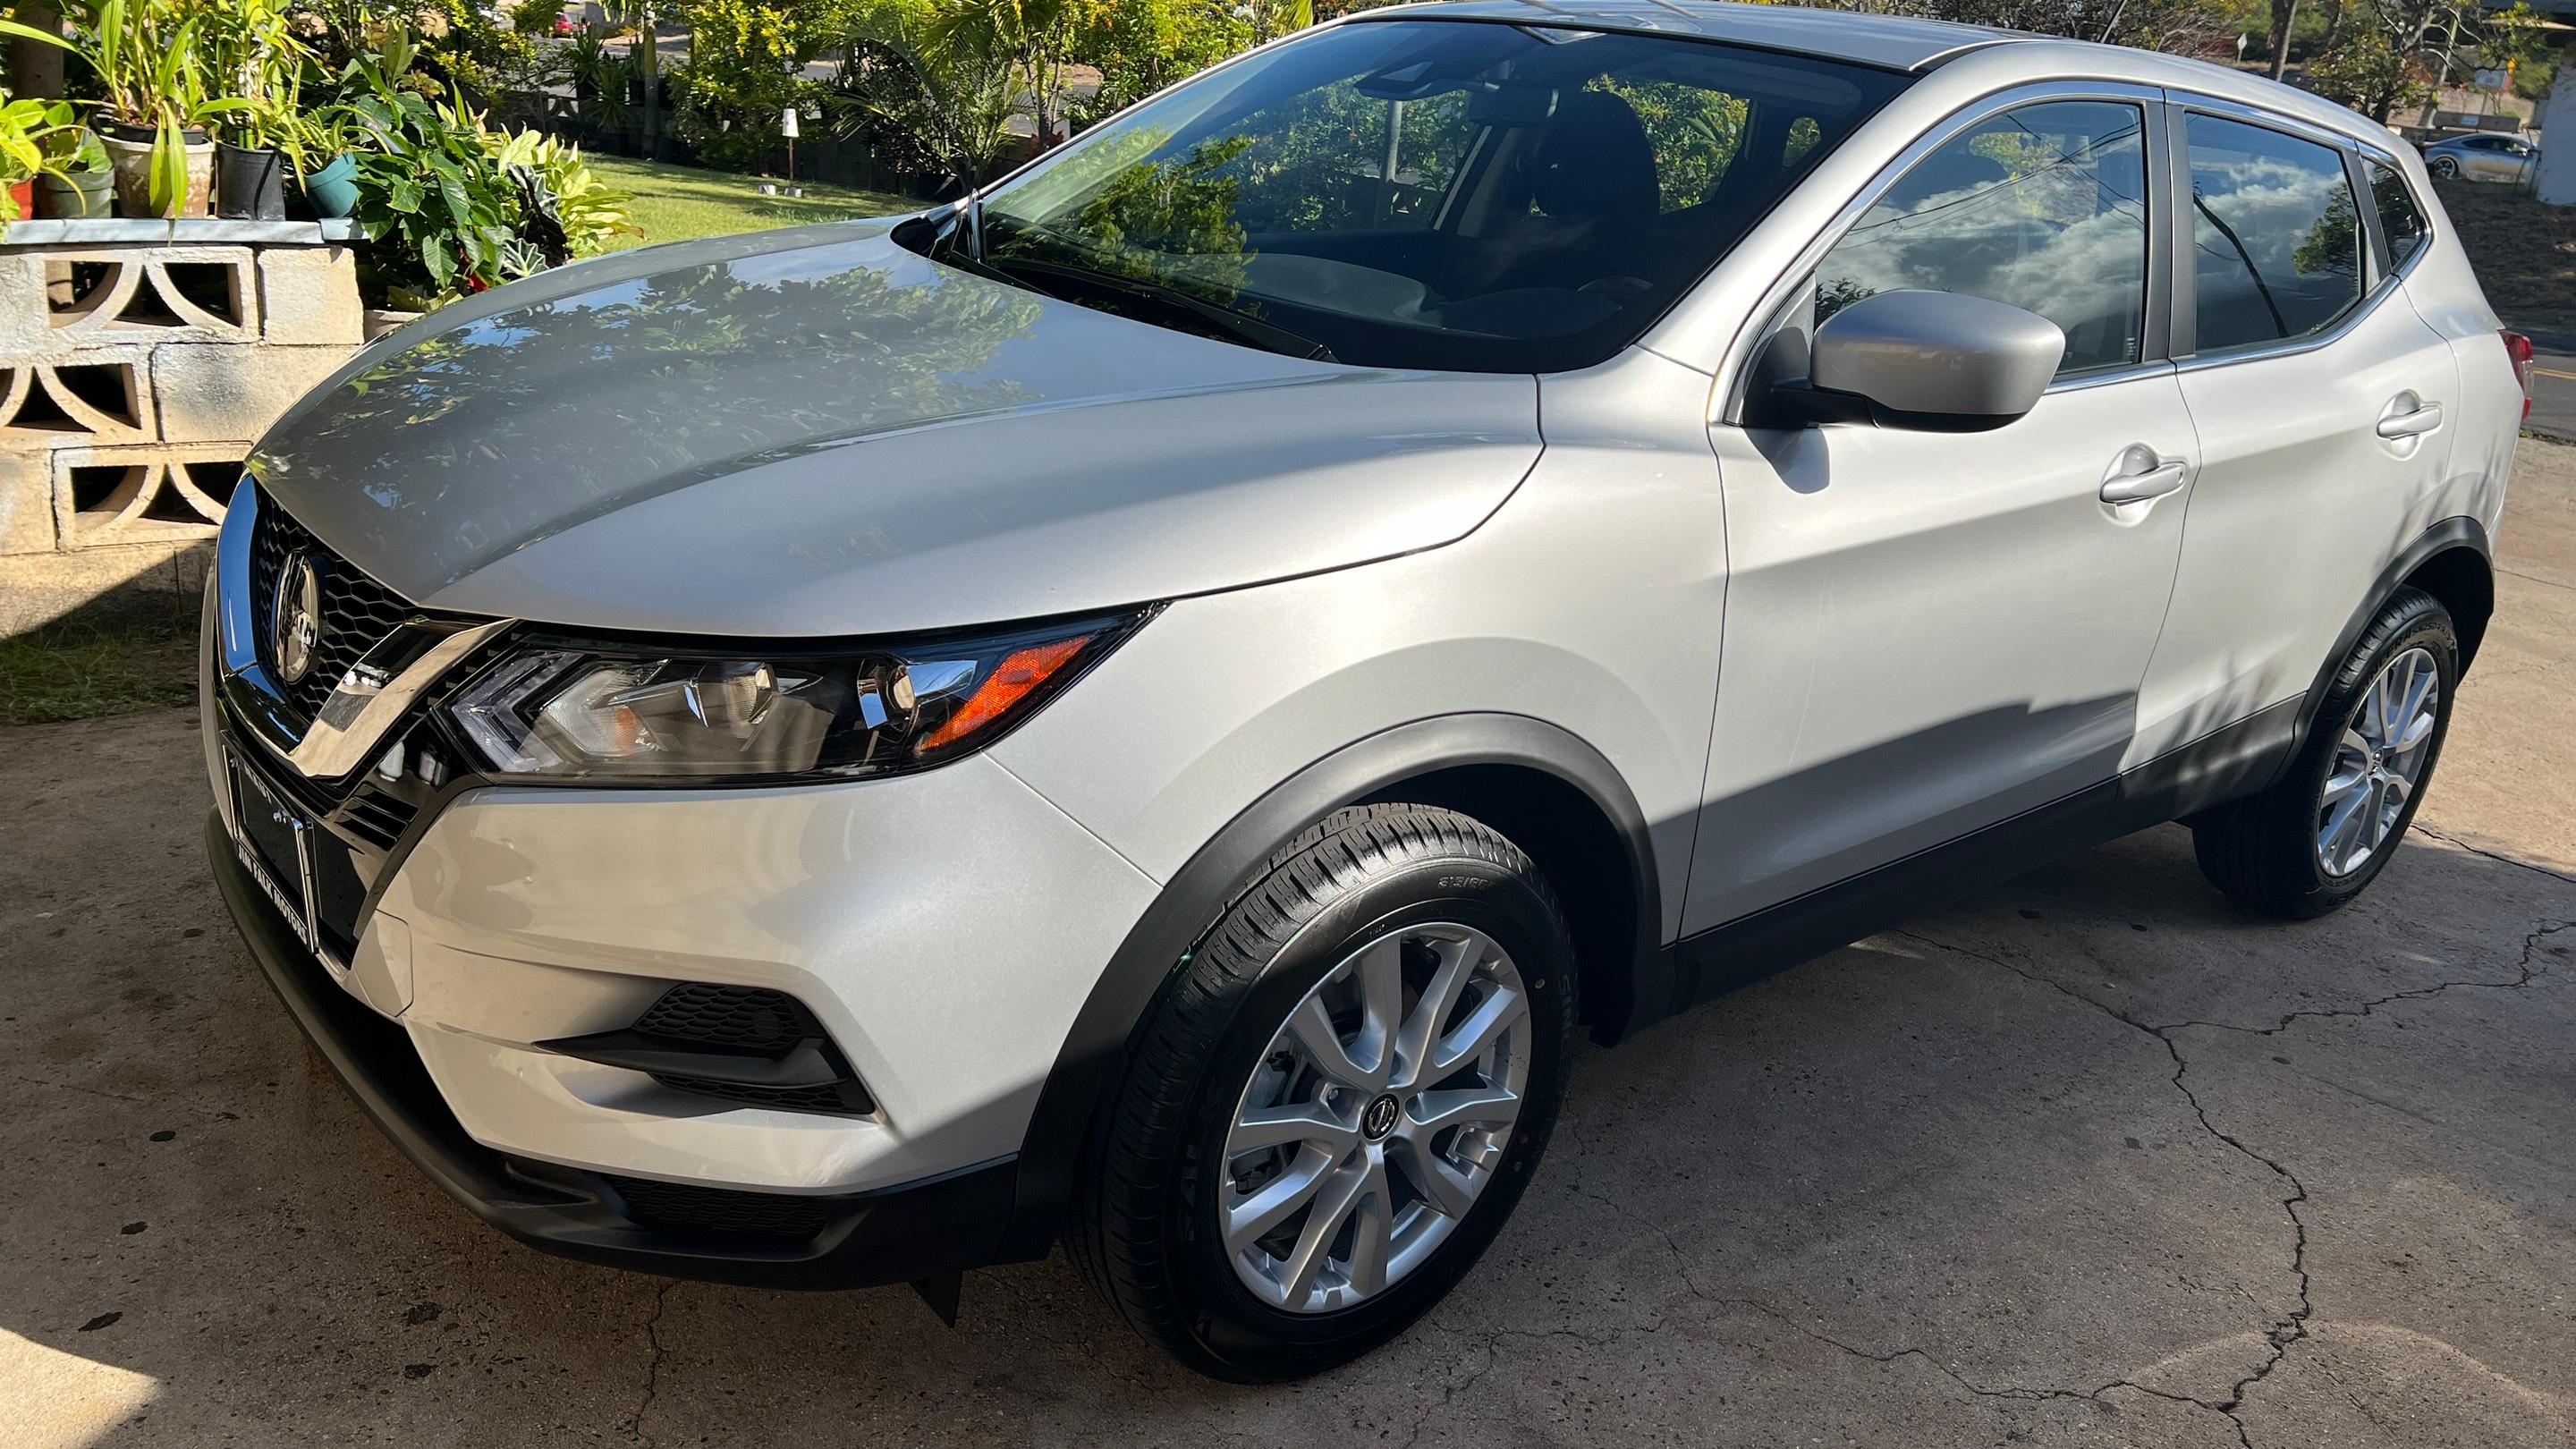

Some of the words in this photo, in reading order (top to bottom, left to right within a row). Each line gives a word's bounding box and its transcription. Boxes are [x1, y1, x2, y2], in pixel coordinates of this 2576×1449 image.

[238, 843, 253, 873] JIM
[252, 860, 274, 900] FALK
[274, 888, 308, 945] MOTORS
